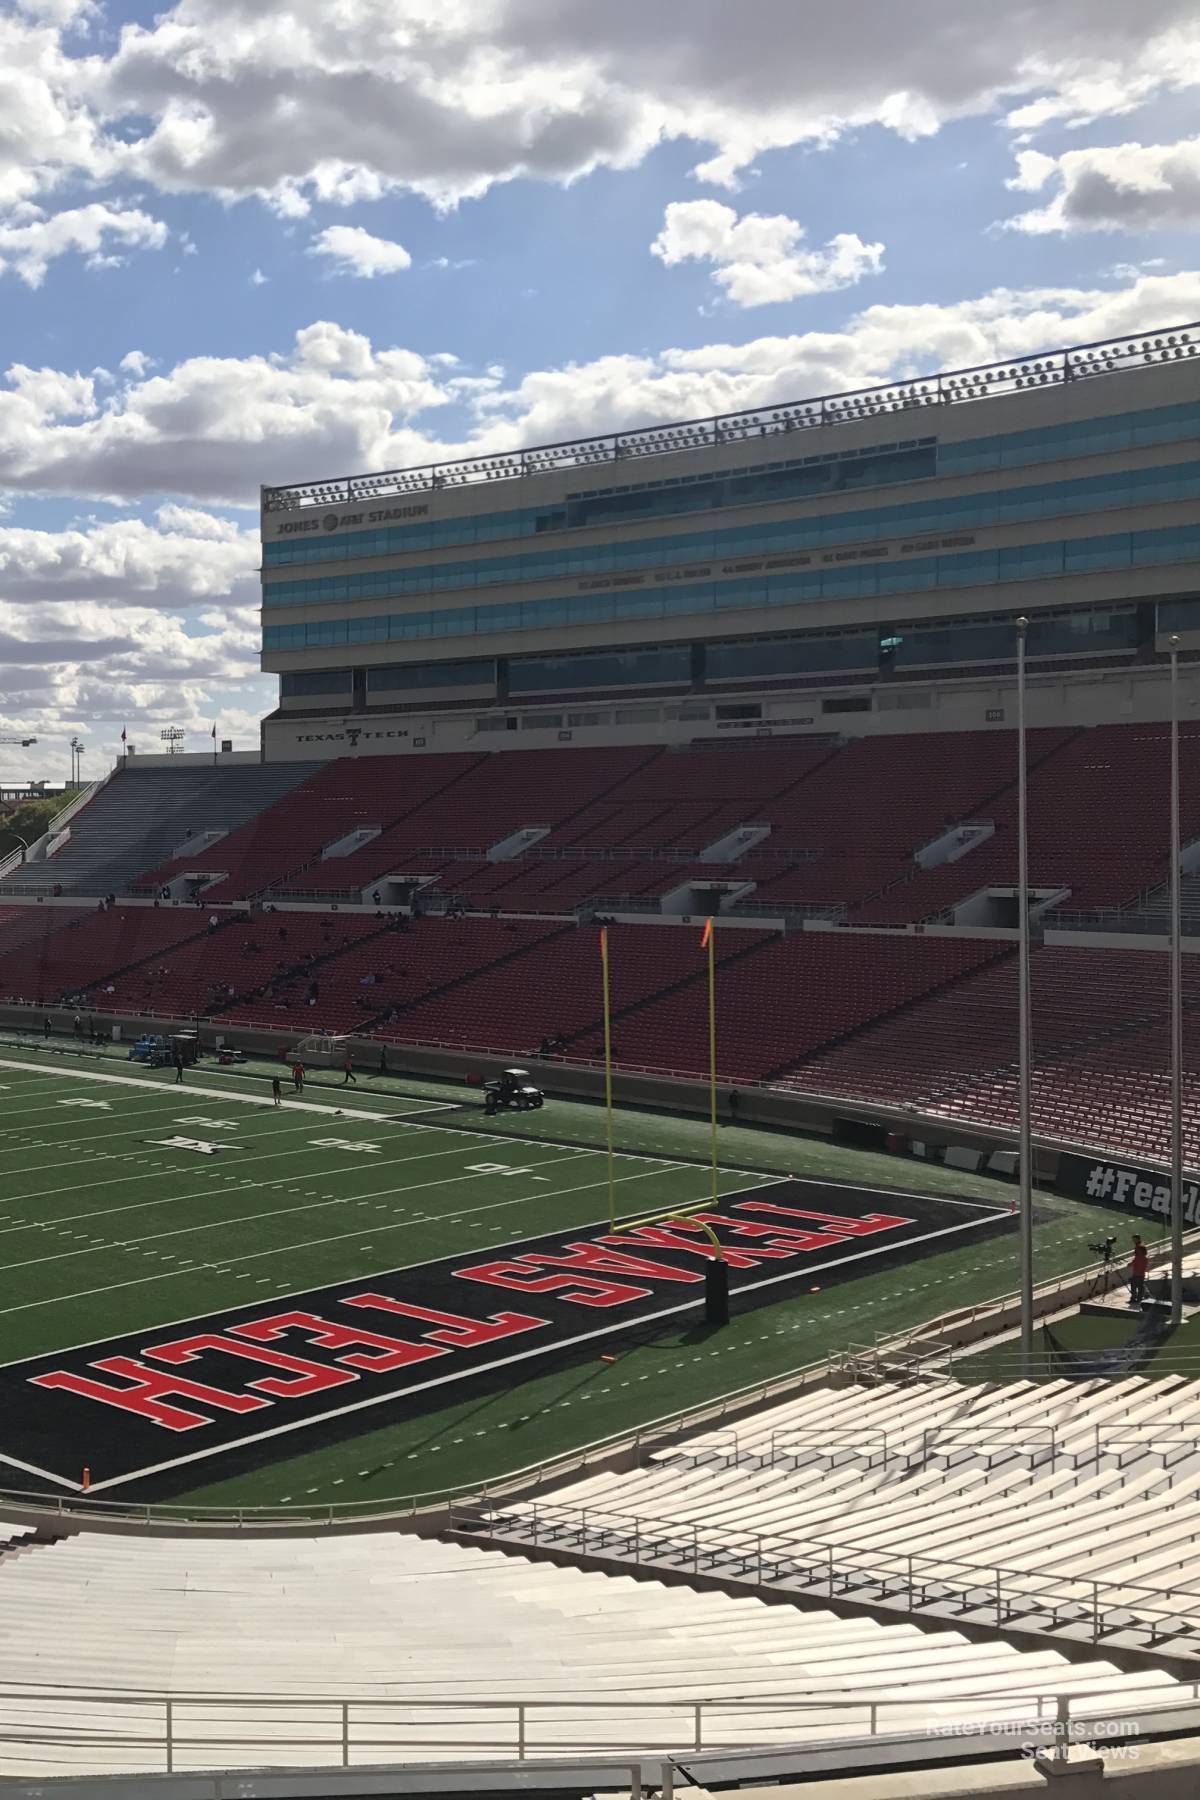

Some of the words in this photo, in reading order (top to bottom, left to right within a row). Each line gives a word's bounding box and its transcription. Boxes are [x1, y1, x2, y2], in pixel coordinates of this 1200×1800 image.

[277, 519, 319, 534] JONES
[368, 504, 429, 522] STADIUM
[296, 733, 345, 743] TEXAS
[365, 729, 409, 740] TECH
[464, 1162, 533, 1176] 10
[1086, 1166, 1200, 1225] #Feal
[452, 1200, 916, 1307] TEXAS
[26, 1292, 553, 1432] TECH
